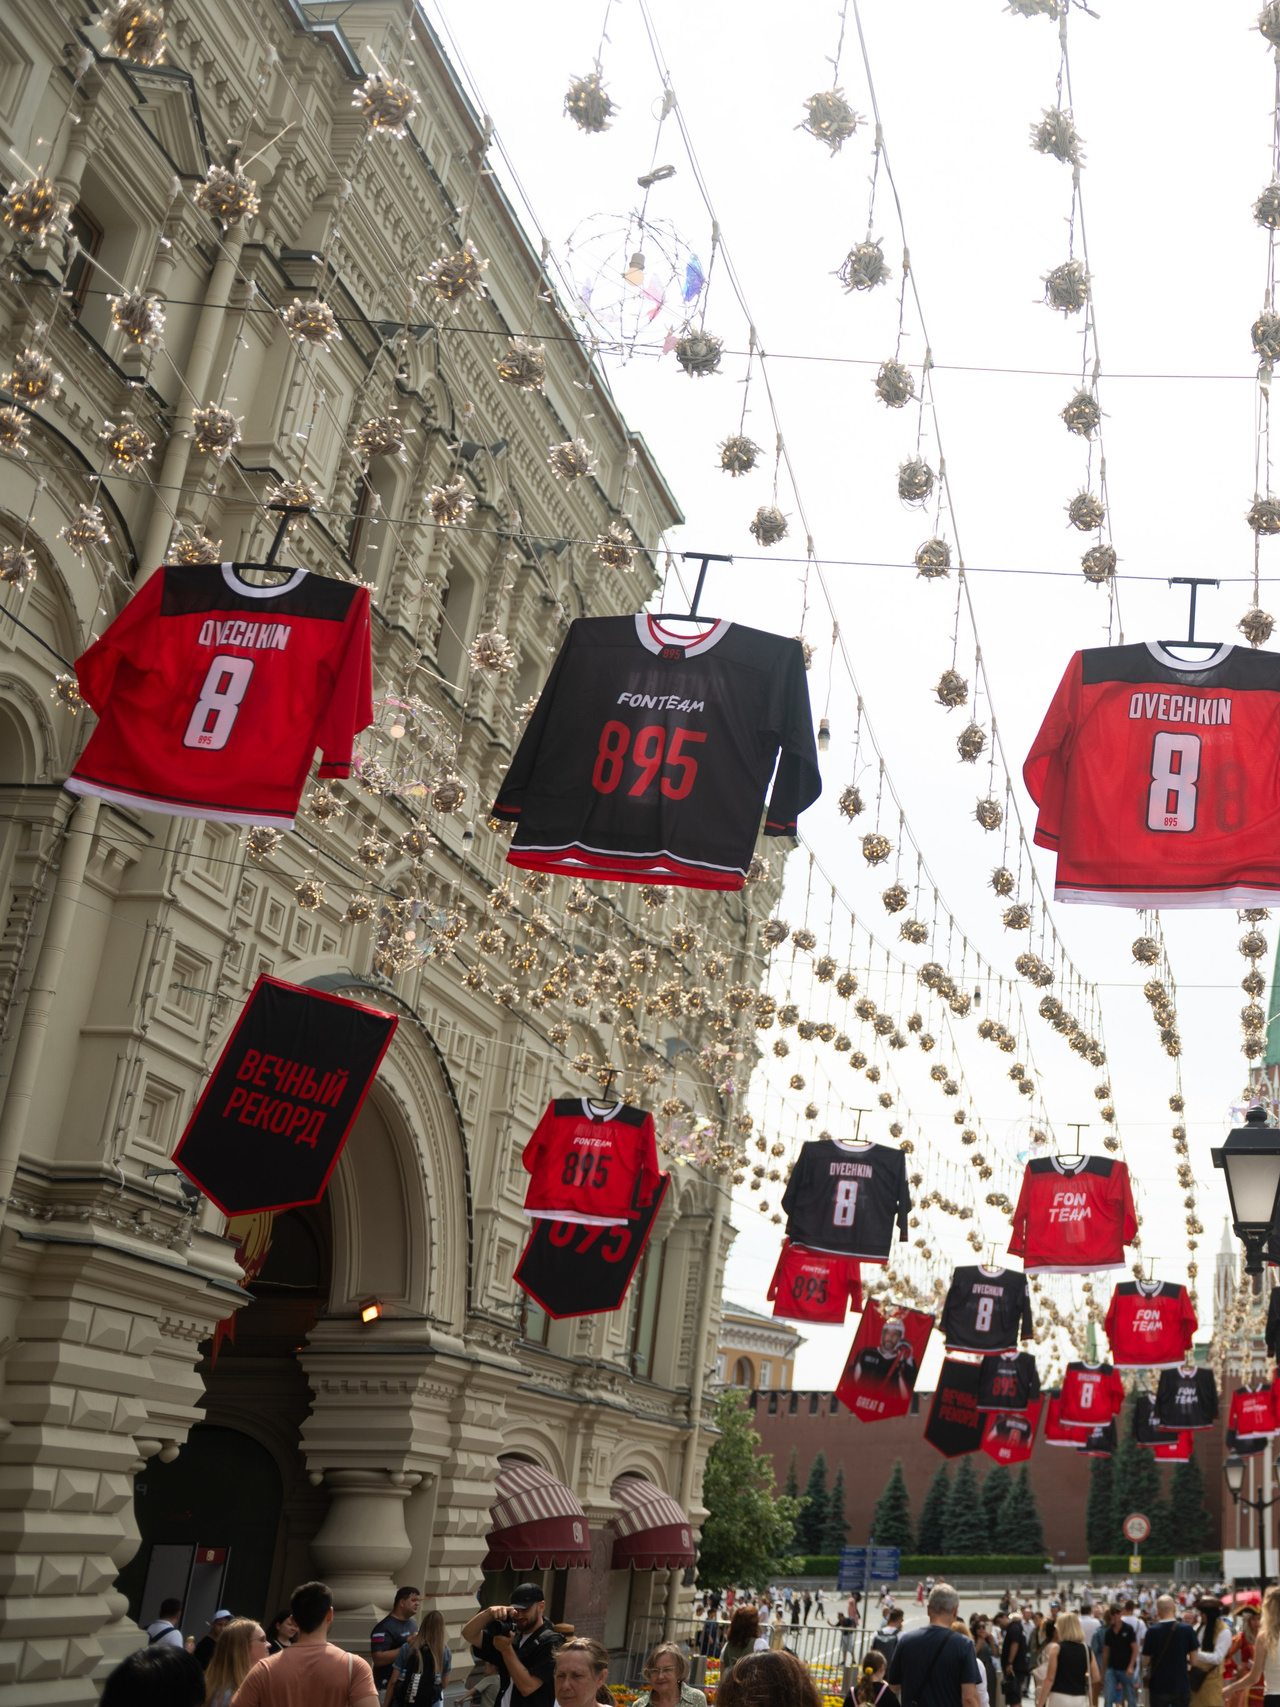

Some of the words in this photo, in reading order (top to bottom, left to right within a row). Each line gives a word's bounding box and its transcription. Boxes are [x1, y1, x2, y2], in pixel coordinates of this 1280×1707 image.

[198, 619, 292, 651] OVECHKIN
[662, 648, 681, 660] 895
[182, 653, 255, 752] 8
[616, 692, 705, 713] FONTEAM
[1128, 692, 1232, 725] OVECHKIN
[591, 719, 708, 801] 895
[1145, 730, 1203, 834] 8
[1163, 817, 1178, 827] 895
[236, 1048, 350, 1108] ВЕЧНЫЙ
[222, 1086, 327, 1149] РЕКОРД
[573, 1137, 612, 1148] FONTEAM
[561, 1151, 612, 1189] 895
[829, 1162, 873, 1179] OVECHKIN
[832, 1179, 859, 1227] 8
[1053, 1192, 1087, 1207] FON
[1048, 1206, 1092, 1223] TEAM
[792, 1275, 829, 1305] 895
[975, 1296, 994, 1332] 8
[1132, 1320, 1163, 1332] TEAM
[1136, 1309, 1160, 1321] FON
[992, 1376, 1019, 1397] 895
[1080, 1383, 1094, 1409] 8
